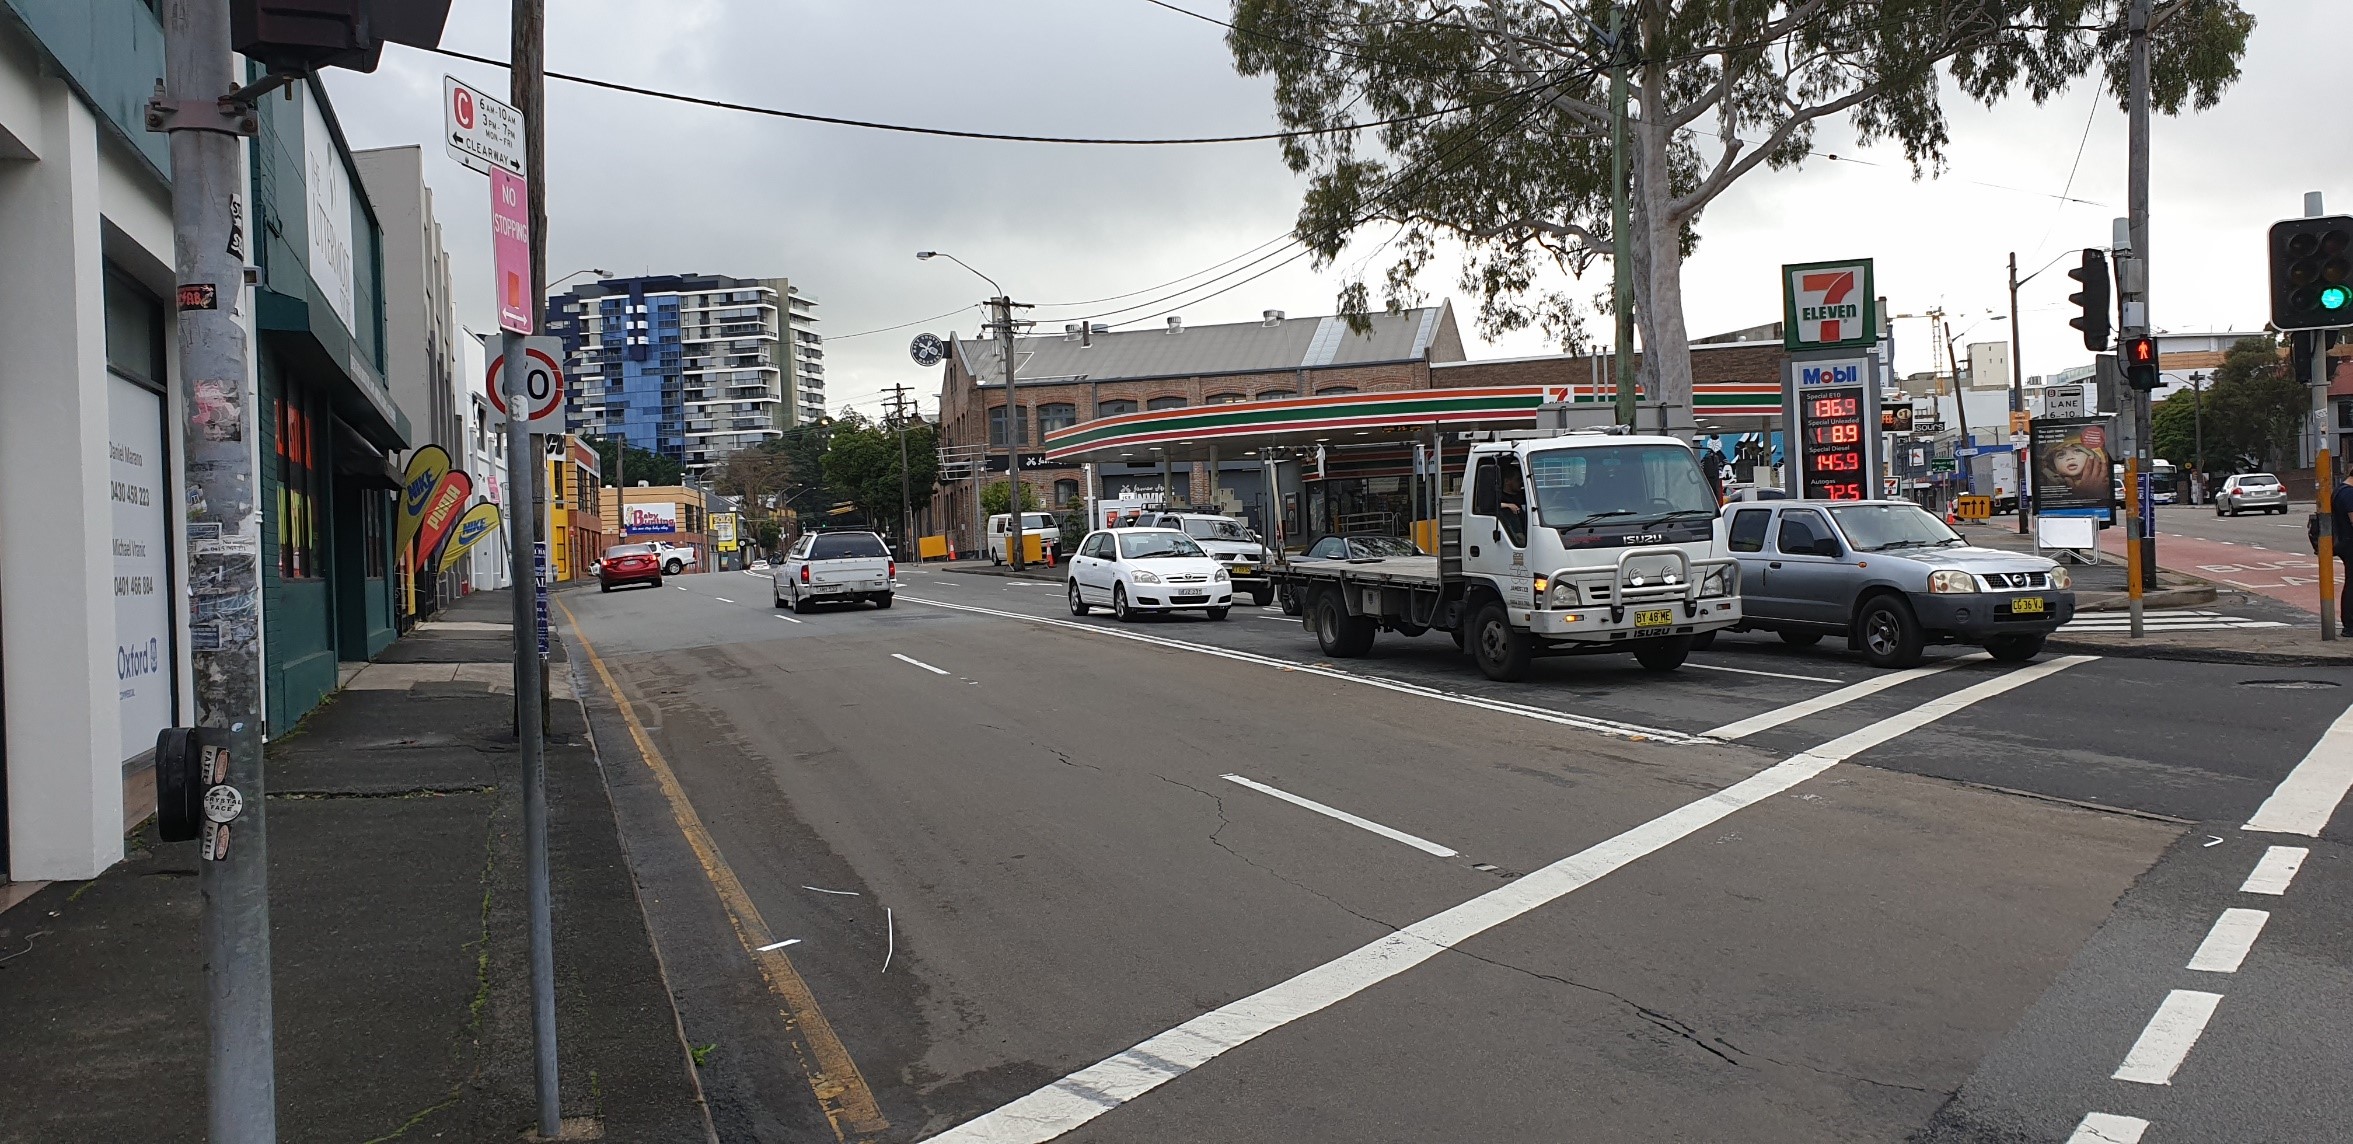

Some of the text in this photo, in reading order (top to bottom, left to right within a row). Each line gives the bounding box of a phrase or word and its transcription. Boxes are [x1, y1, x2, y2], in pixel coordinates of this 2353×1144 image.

[458, 92, 469, 125] C
[466, 138, 508, 165] CLEARWAY
[502, 184, 516, 207] NO
[495, 213, 527, 243] STOPPING
[1803, 271, 1854, 342] 7
[1803, 366, 1857, 385] Mobil
[1815, 398, 1856, 417] 136.9
[1808, 419, 1829, 427] Special
[1817, 452, 1858, 470] 145.9
[407, 468, 433, 502] NIKE
[427, 484, 461, 530] PUMA
[463, 517, 487, 534] NIKE
[1623, 534, 1662, 544] ISUZU
[1634, 628, 1670, 637] ISUZU
[117, 642, 148, 680] Oxford
[204, 795, 242, 805] CRYSTAL
[210, 804, 232, 812] FACE
